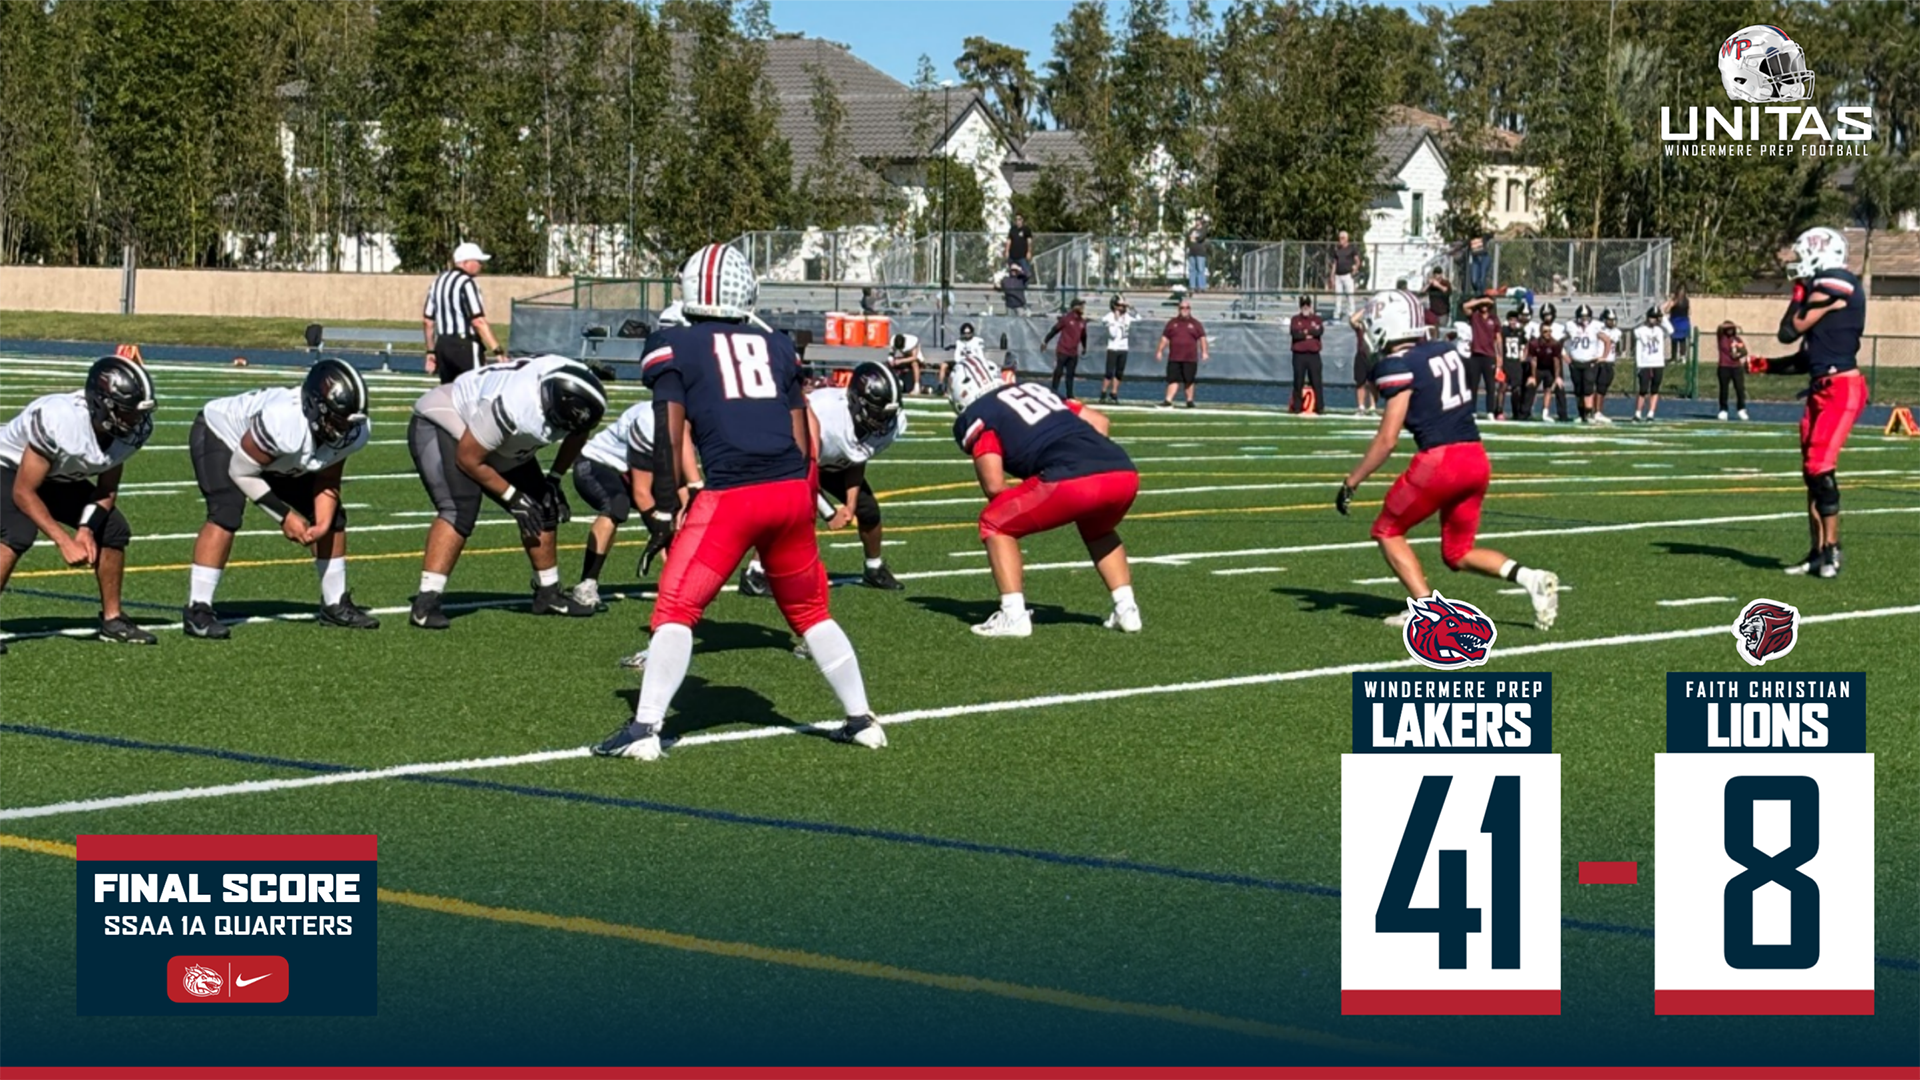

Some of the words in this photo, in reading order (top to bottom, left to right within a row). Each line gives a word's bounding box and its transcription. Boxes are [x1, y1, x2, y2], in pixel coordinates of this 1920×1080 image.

[713, 332, 777, 399] 18
[1428, 350, 1472, 411] 22
[997, 382, 1069, 426] 68
